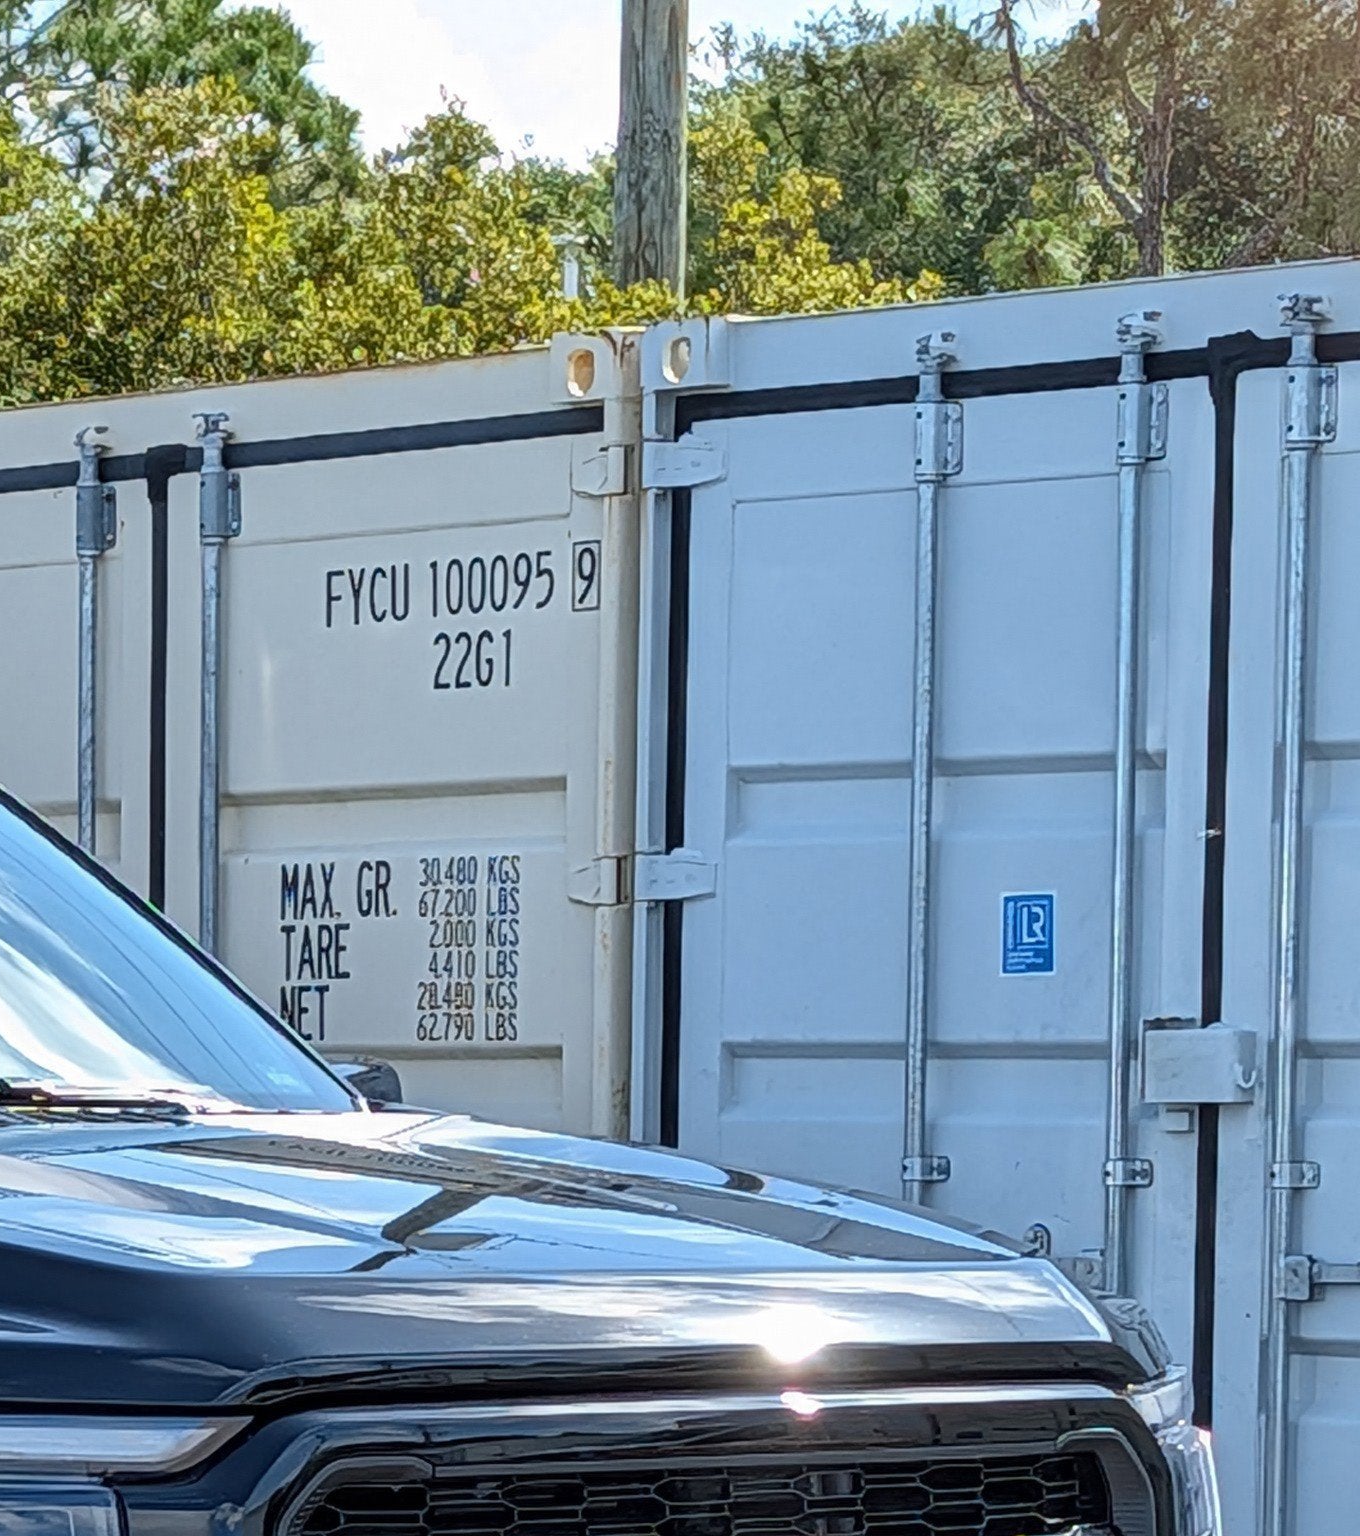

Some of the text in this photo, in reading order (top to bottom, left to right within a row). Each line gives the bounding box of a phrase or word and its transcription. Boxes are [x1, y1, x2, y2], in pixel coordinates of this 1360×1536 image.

[326, 547, 597, 628] FYCU 100095 9
[432, 628, 512, 690] 22G1
[281, 862, 342, 921] MAX.
[357, 860, 398, 918] GR.
[487, 855, 520, 884] KGS
[486, 887, 520, 917] LBS
[280, 922, 351, 981] TARE
[485, 918, 520, 948] KGS
[485, 950, 519, 979] LBS
[280, 984, 330, 1041] NET
[484, 981, 518, 1010] KGS
[484, 1012, 518, 1041] LBS
